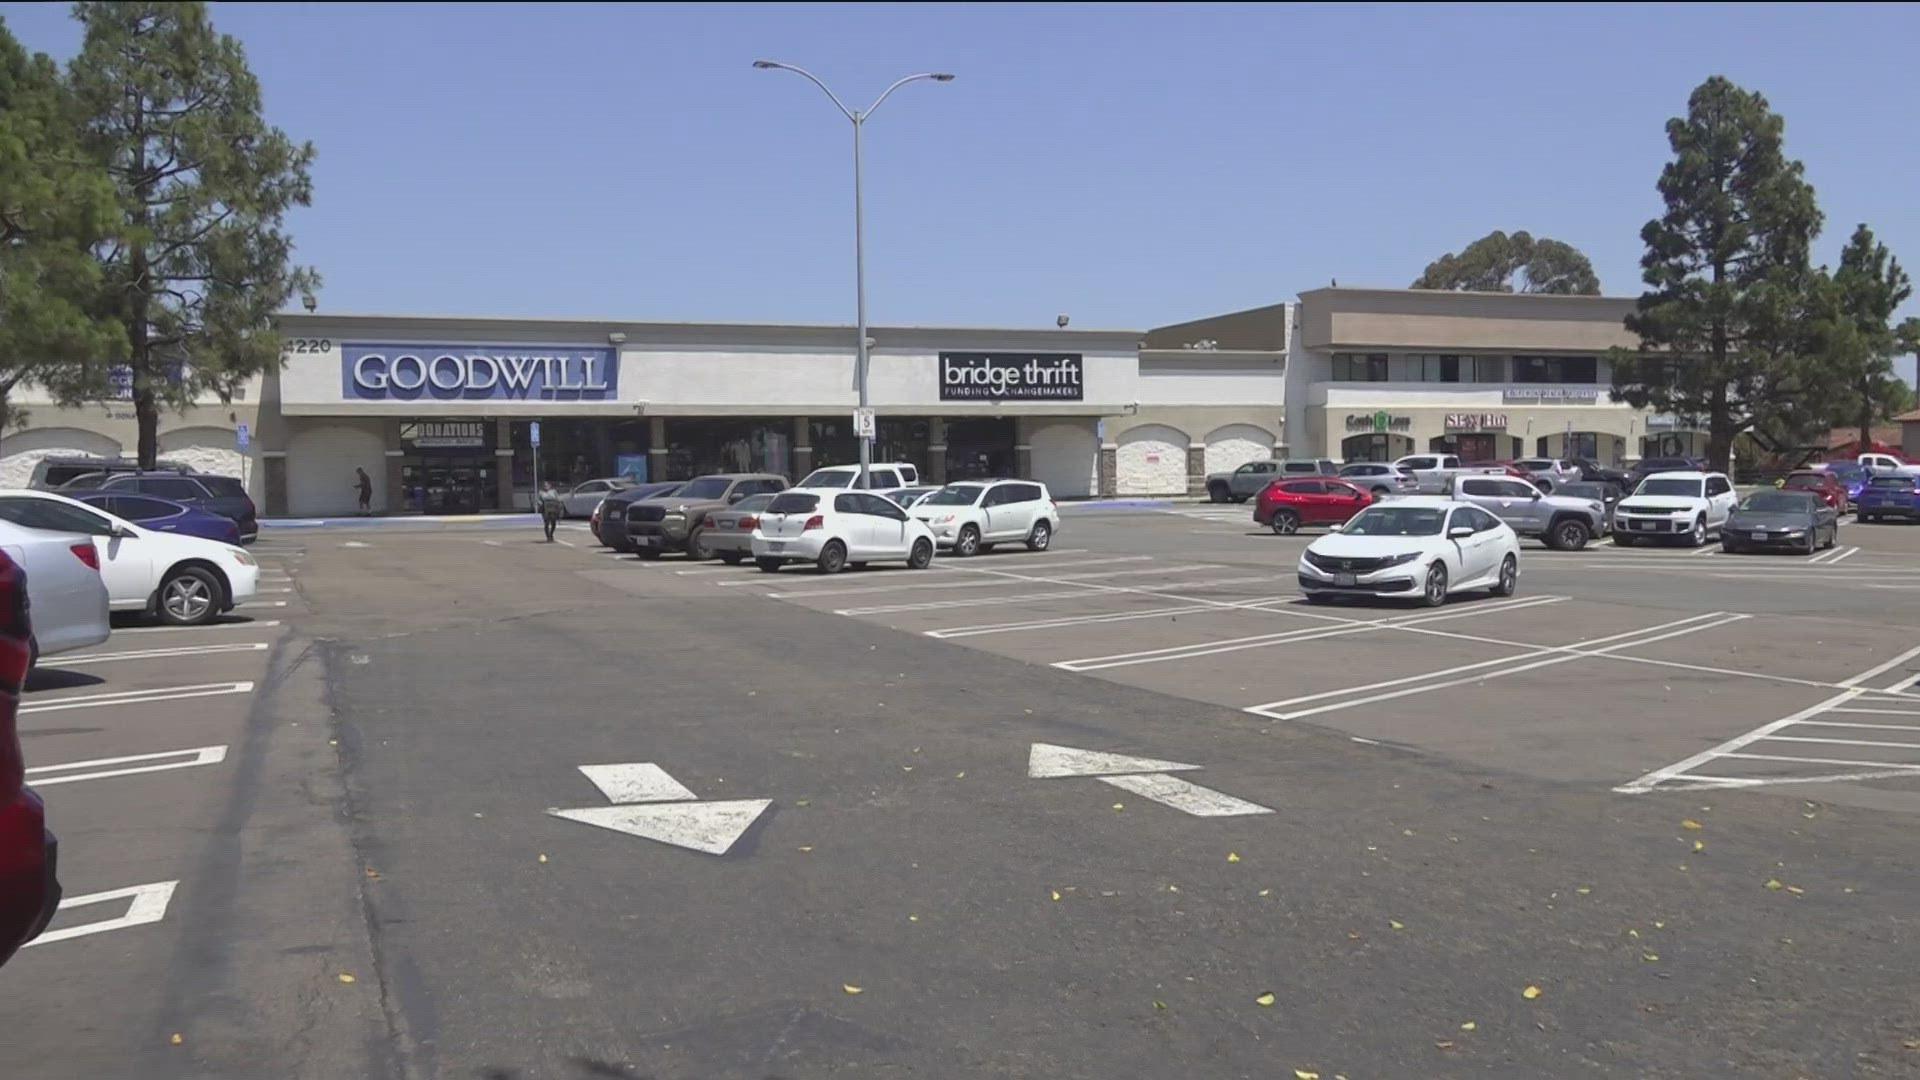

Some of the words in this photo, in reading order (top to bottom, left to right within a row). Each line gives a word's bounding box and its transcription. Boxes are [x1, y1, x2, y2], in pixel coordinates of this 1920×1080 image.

[283, 339, 331, 353] 4220
[354, 354, 607, 390] GOODWILL
[945, 358, 1020, 395] bridge
[1023, 359, 1080, 385] thrift
[945, 387, 990, 396] FUNDING
